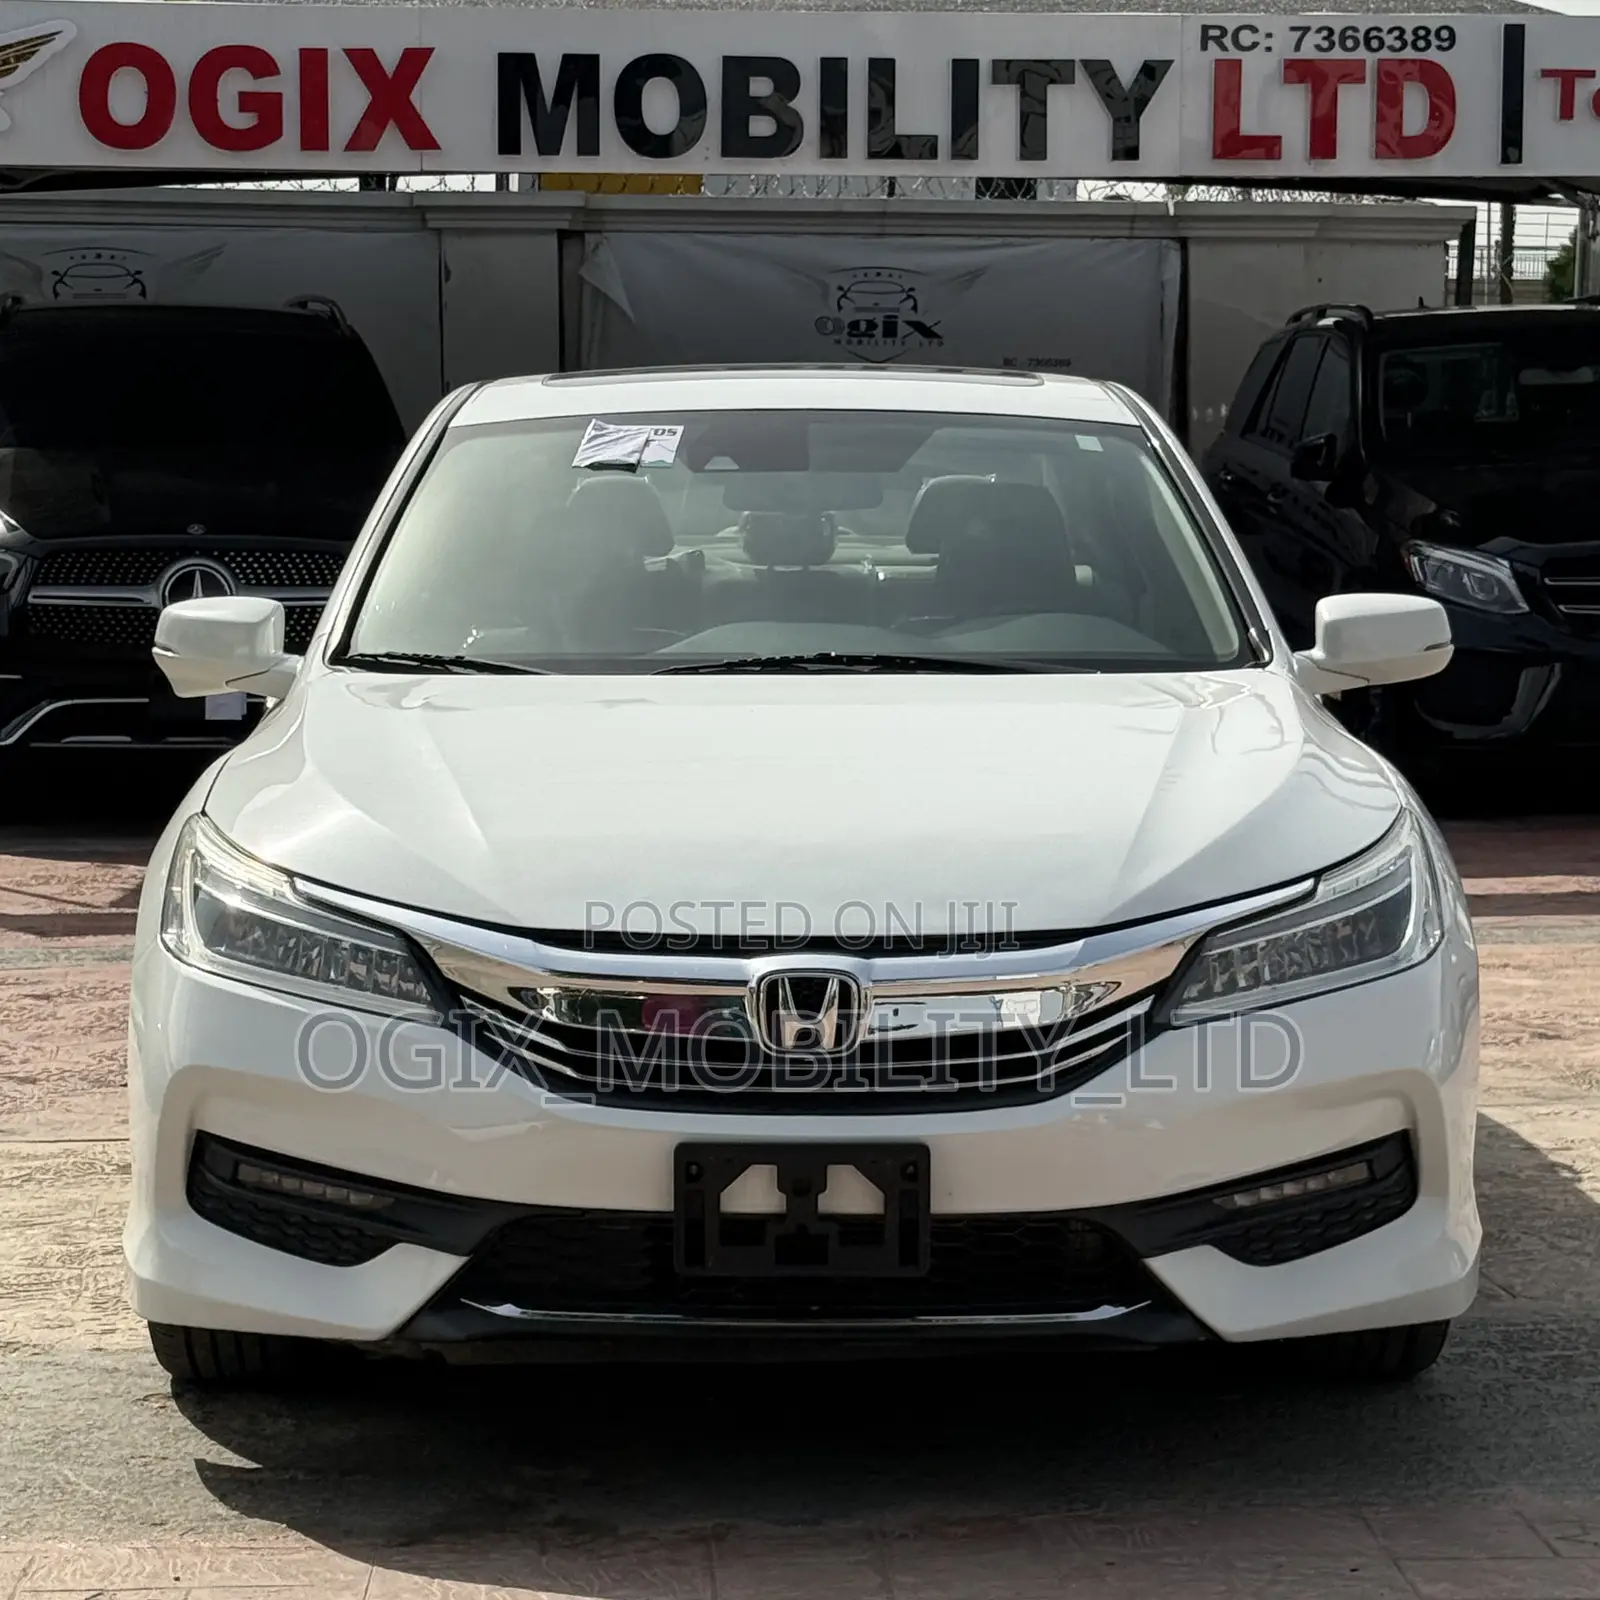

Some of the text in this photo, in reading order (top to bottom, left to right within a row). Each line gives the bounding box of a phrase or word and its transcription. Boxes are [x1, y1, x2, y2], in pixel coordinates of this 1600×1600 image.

[1200, 24, 1457, 53] RC: 7366389
[79, 42, 1457, 161] OGIX MOBILITY LTD
